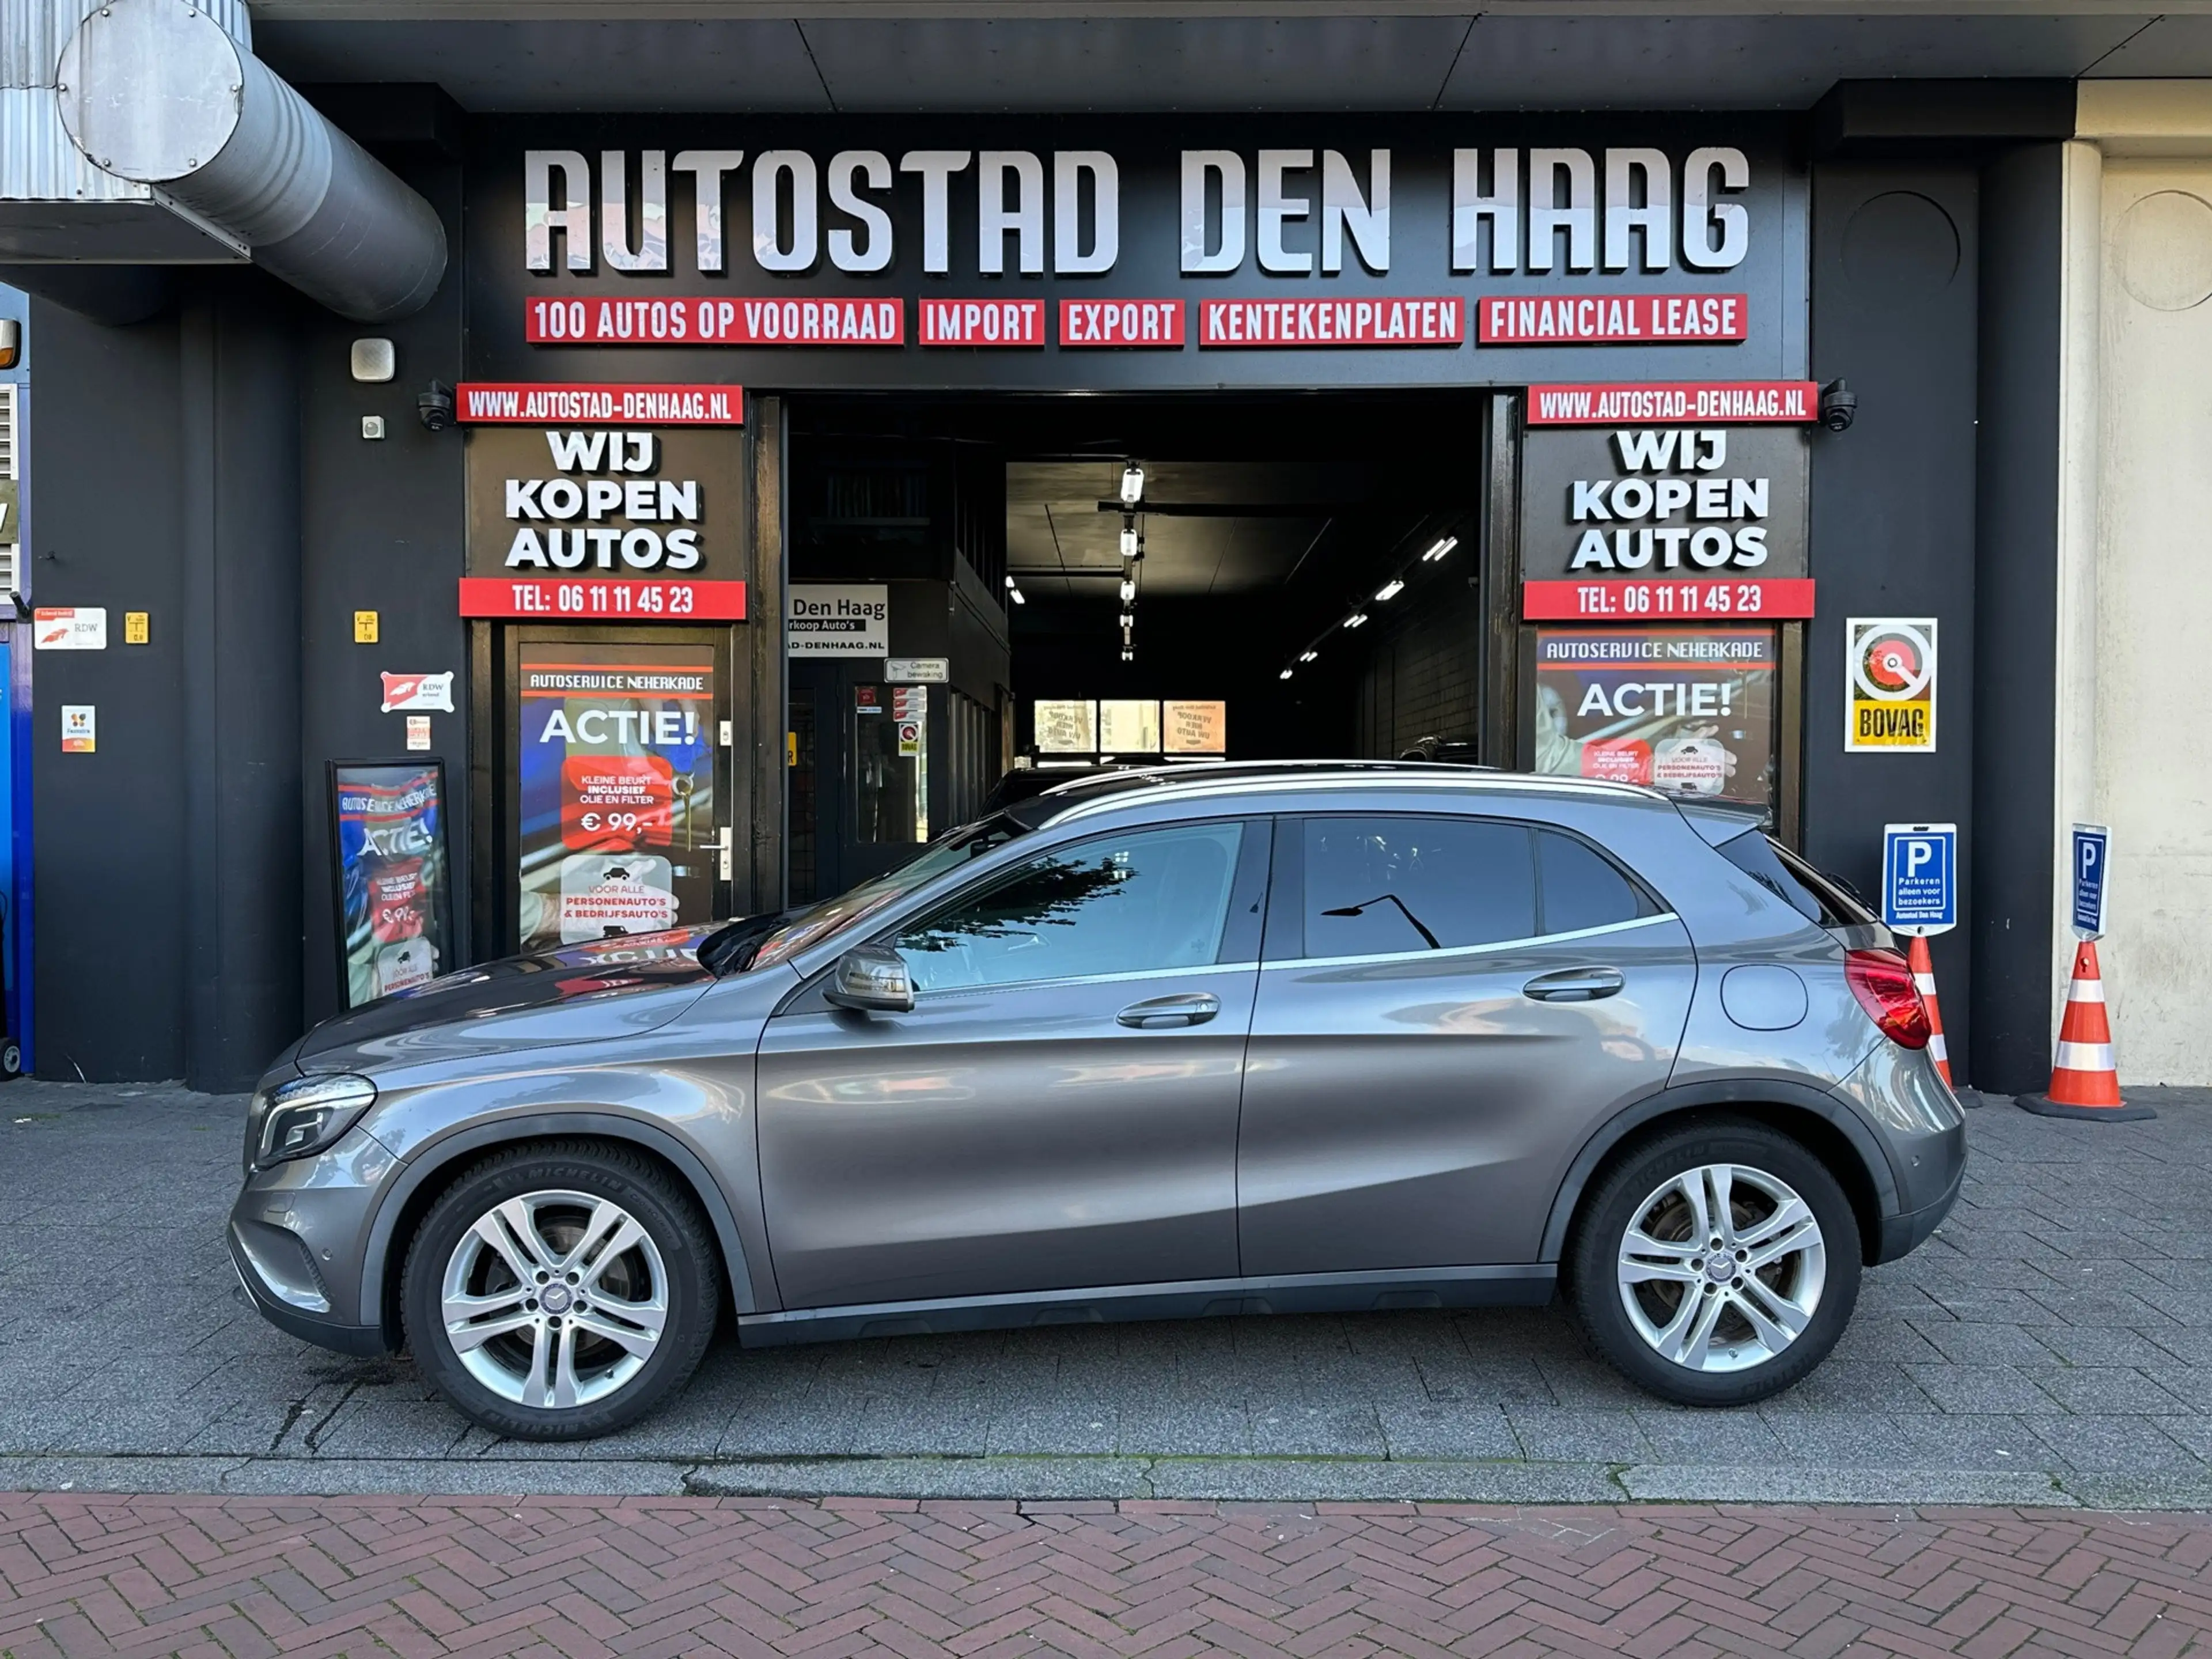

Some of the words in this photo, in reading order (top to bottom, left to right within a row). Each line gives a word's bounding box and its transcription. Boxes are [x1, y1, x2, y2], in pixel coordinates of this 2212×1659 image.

[525, 150, 1119, 273] AUTOSTAD
[1180, 148, 1391, 272] DEN
[1452, 147, 1749, 270] HAAG
[535, 301, 585, 338] 100
[597, 301, 687, 339] AUTOS
[698, 302, 734, 339] OP
[745, 302, 895, 339] VOORRAAD
[926, 303, 1037, 340] IMPORT
[1068, 303, 1175, 340] EXPORT
[1209, 301, 1456, 340] KENTEKENPLATEN
[1491, 298, 1641, 338] FINANCIAL
[1652, 298, 1737, 336] LEASE
[468, 391, 731, 420] WWW.AUTOSTAD-DENHAAG.NL
[1540, 389, 1806, 419] WWW.AUTOSTAD-DENHAAG.NL
[546, 431, 653, 472] WIJ
[1616, 429, 1726, 471] WIJ
[505, 479, 698, 520] KOPEN
[1573, 478, 1769, 520] KOPEN
[505, 528, 700, 570] AUTOS
[1571, 526, 1768, 569] AUTOS
[512, 584, 550, 611] TEL:
[558, 585, 584, 611] 06
[589, 585, 607, 612] 11
[613, 586, 631, 612] 11
[637, 586, 662, 613] 45
[669, 586, 693, 613] 23
[793, 599, 831, 616] Den
[838, 599, 885, 620] Haag
[1577, 586, 1616, 613] TEL:
[1624, 586, 1649, 612] 06
[1656, 586, 1673, 612] 11
[1680, 586, 1698, 612] 11
[1704, 585, 1730, 612] 45
[1737, 585, 1762, 611] 23
[74, 623, 98, 632] RDW
[822, 620, 855, 630] Auto's
[1547, 642, 1662, 658] AUTOSERVICE
[1667, 642, 1763, 658] NEHERKADE
[530, 674, 624, 689] AUTOSERVICE
[627, 675, 703, 690] NEHERKADE
[907, 671, 943, 679] bewaking
[1577, 683, 1732, 717] ACTIE!
[539, 709, 695, 745] ACTIE!
[1860, 708, 1924, 737] BOVAG
[581, 776, 616, 784] KLEINE
[619, 775, 652, 784] BEURT
[588, 786, 646, 794] INCLUSIEF
[579, 795, 603, 804] OLIE
[605, 796, 619, 804] EN
[622, 796, 654, 804] FILTER
[581, 812, 601, 831] €
[608, 813, 653, 834] 99,-
[1907, 841, 1932, 877] P
[2082, 842, 2097, 878] P
[566, 897, 666, 906] PERSONENAUTO'S
[589, 885, 619, 893] VOOR
[621, 885, 645, 893] ALLE
[1899, 897, 1940, 906] bezoekers
[564, 910, 573, 918] &
[575, 910, 668, 918] BEDRIJFSAUTO'S
[528, 1167, 621, 1190] MICHELIN
